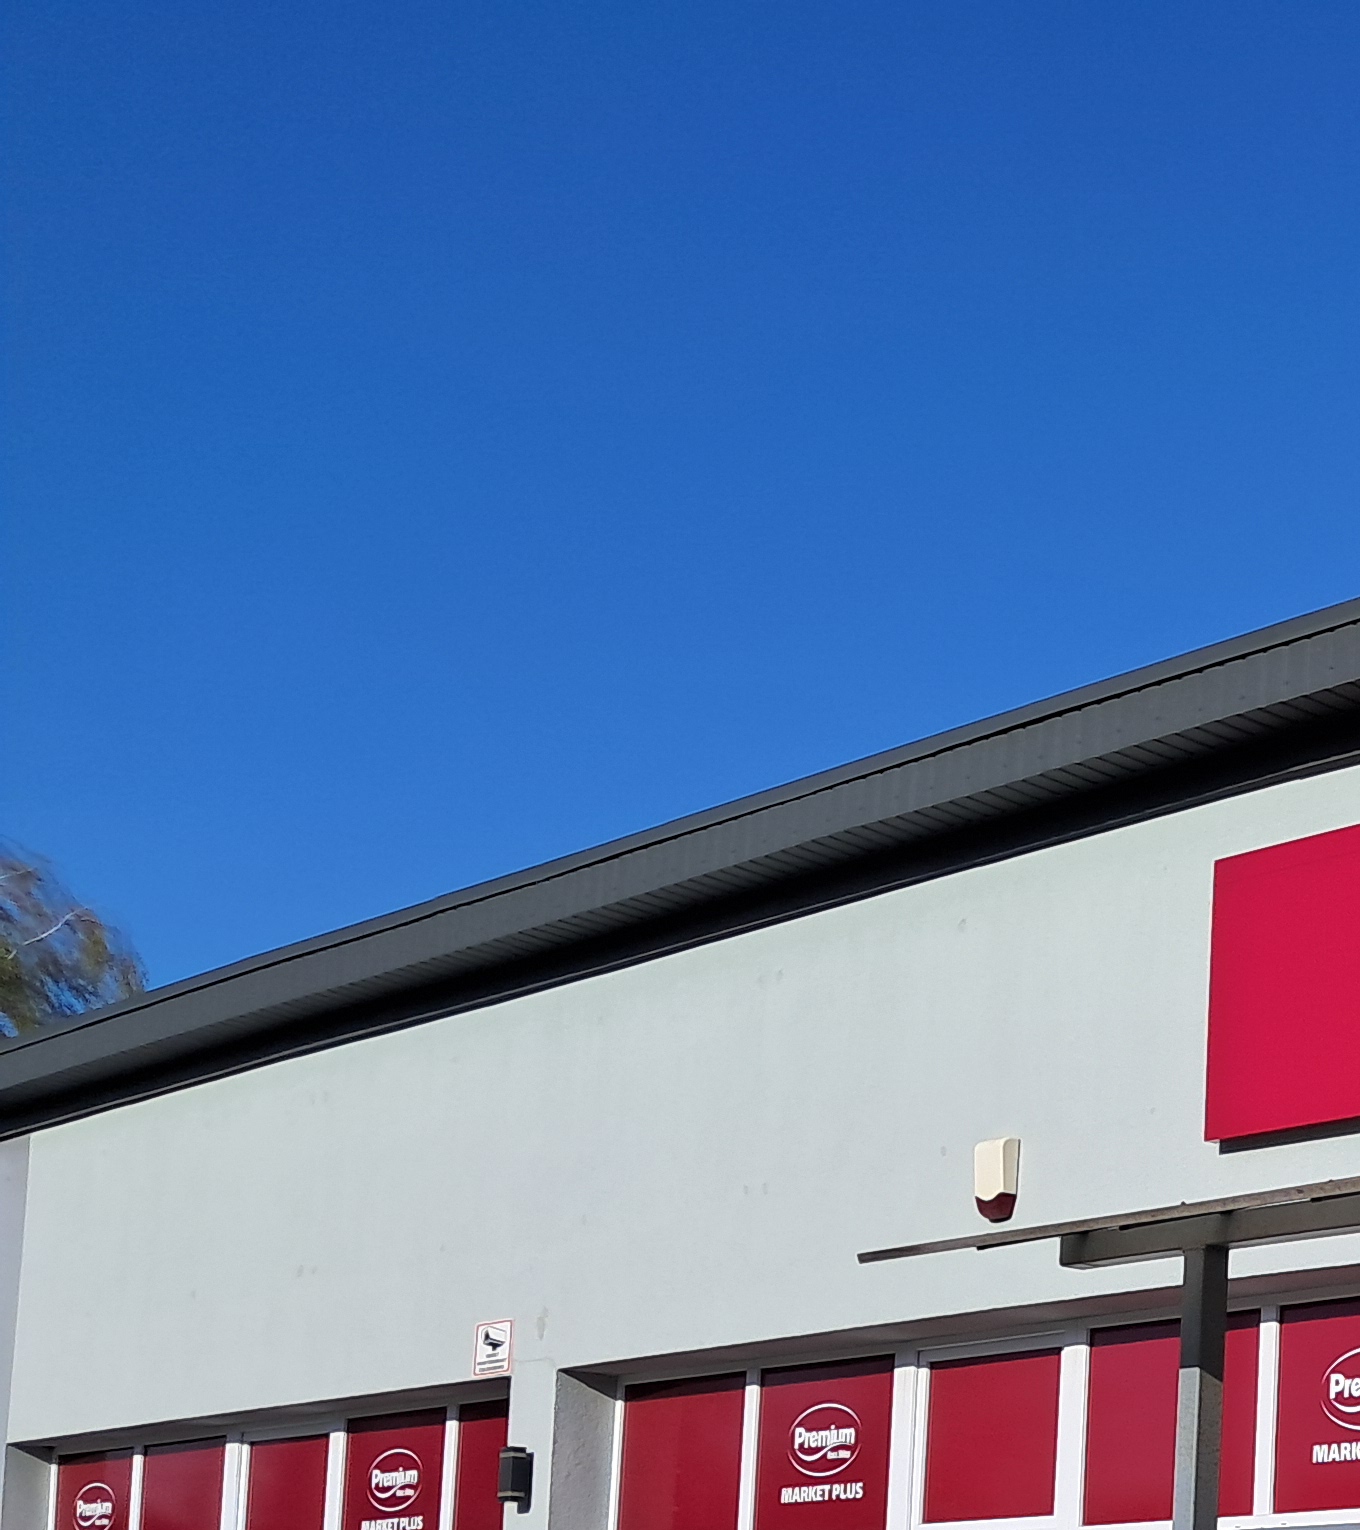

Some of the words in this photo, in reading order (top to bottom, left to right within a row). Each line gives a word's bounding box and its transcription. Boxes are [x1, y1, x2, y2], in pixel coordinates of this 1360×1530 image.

[794, 1425, 856, 1450] Premium
[371, 1467, 419, 1489] Premium
[780, 1485, 831, 1504] MARKET
[832, 1482, 864, 1500] PLUS
